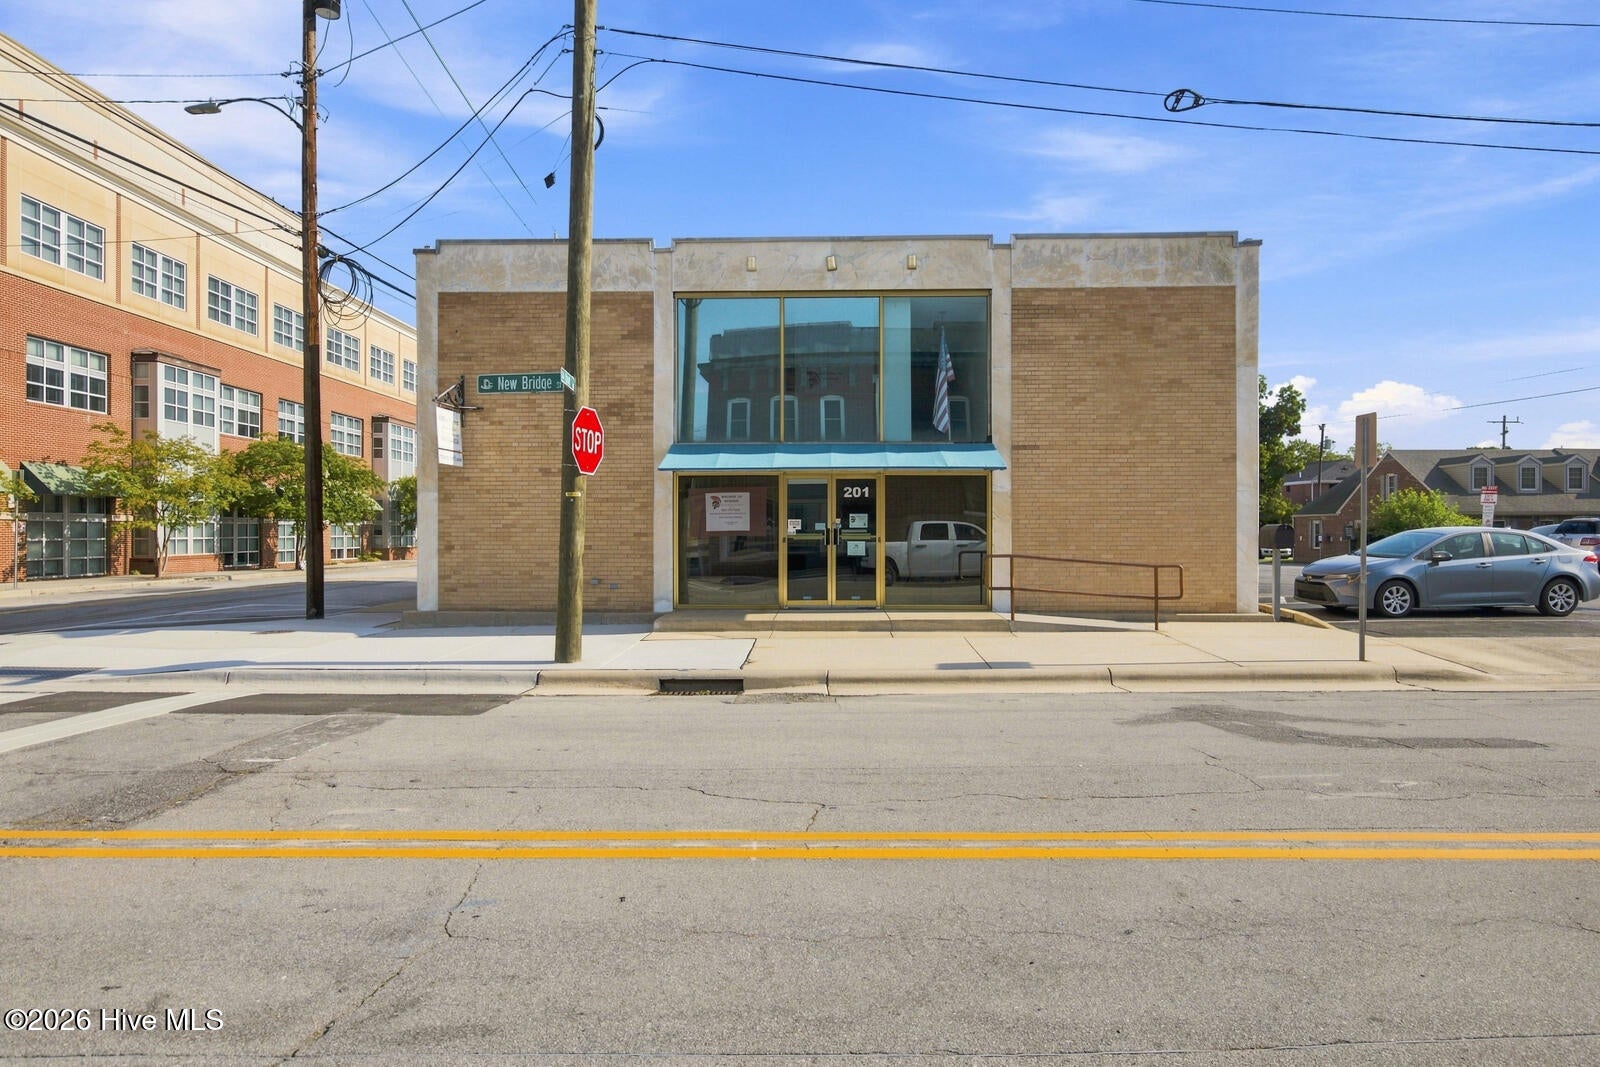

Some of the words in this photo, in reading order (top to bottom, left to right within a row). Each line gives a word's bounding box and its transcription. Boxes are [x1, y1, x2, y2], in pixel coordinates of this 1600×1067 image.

[497, 376, 518, 390] New
[521, 375, 552, 391] Bridge
[574, 427, 602, 454] STOP
[843, 486, 869, 498] 201
